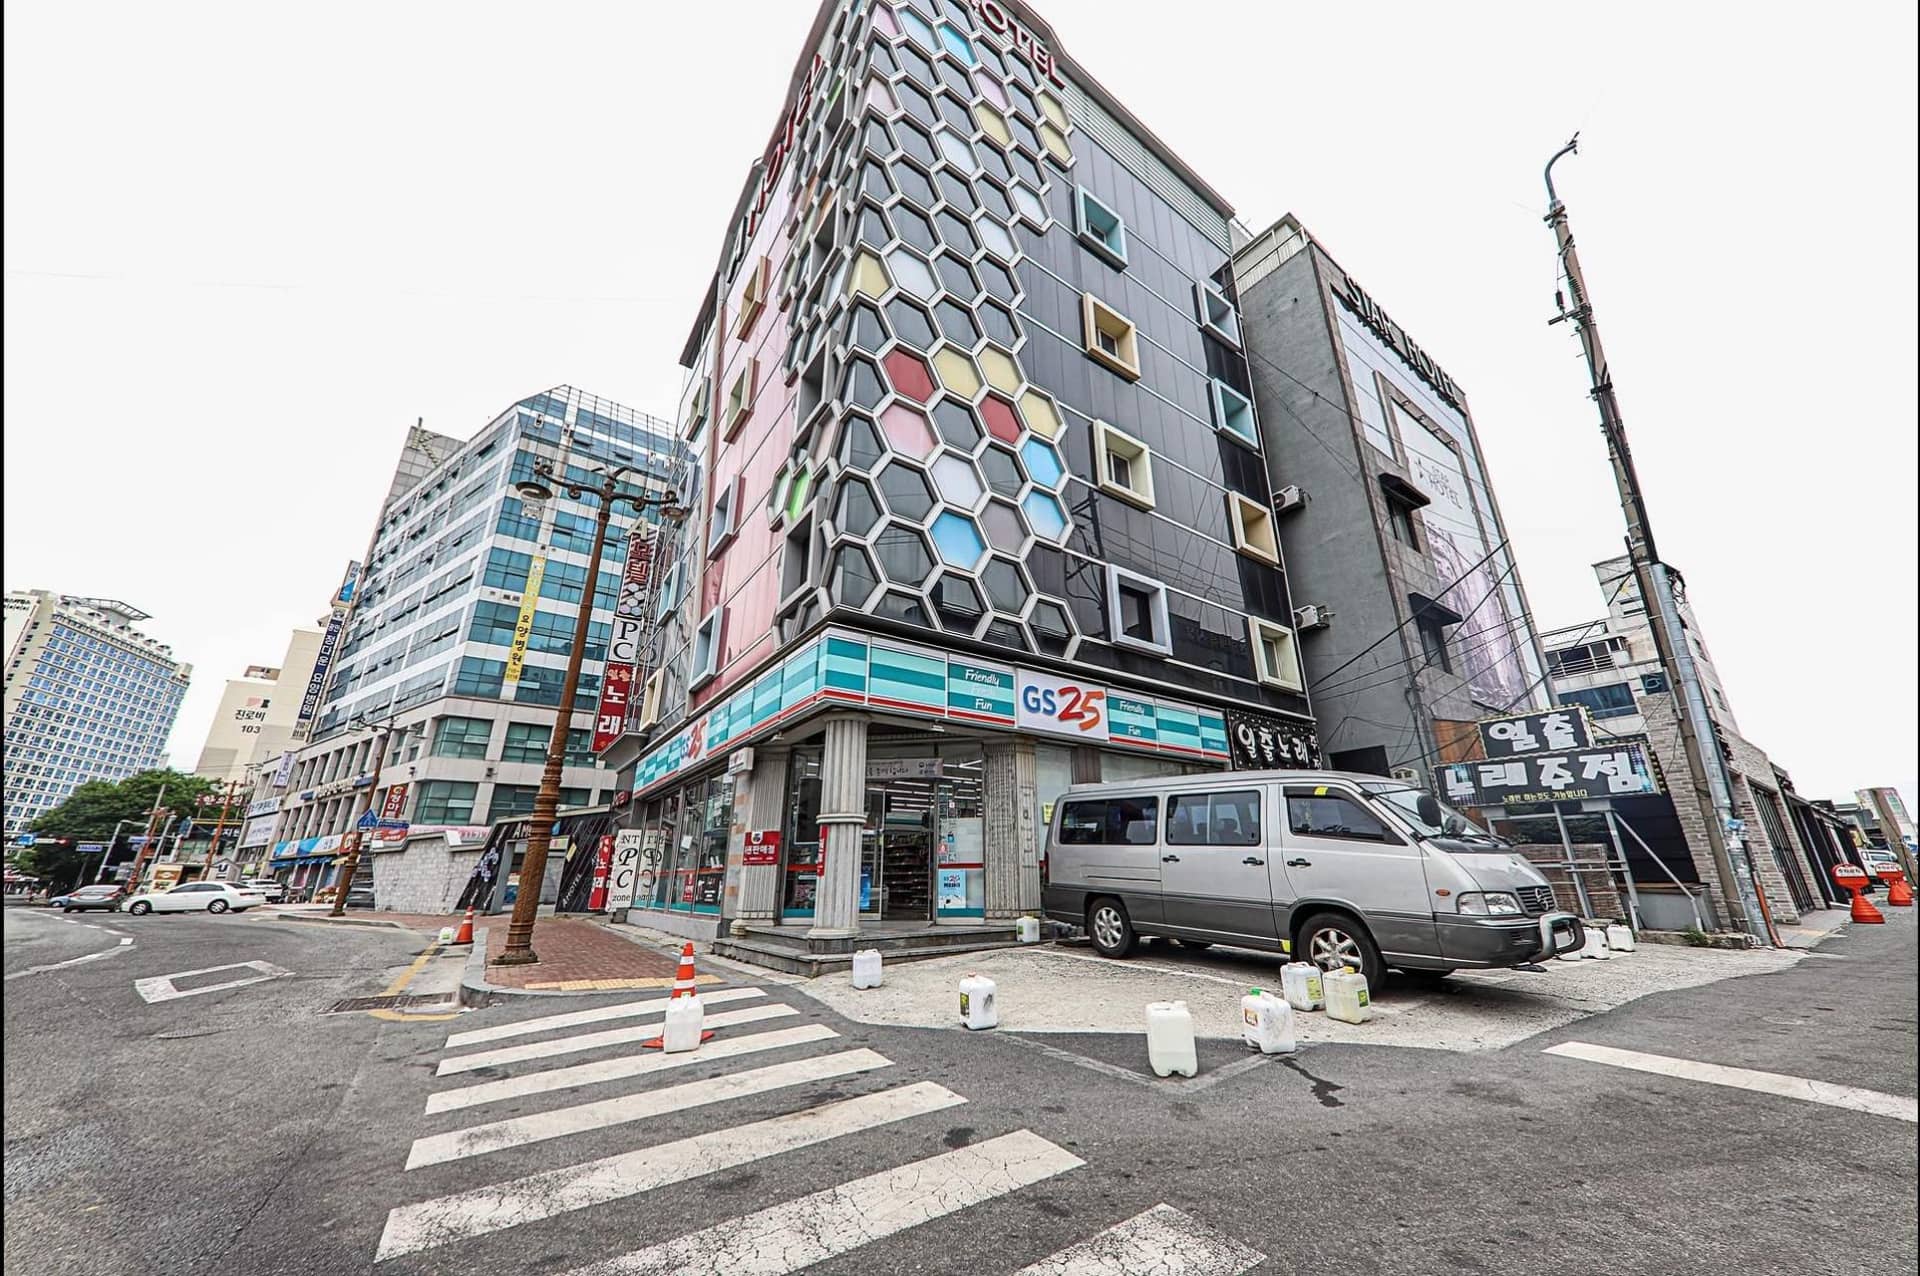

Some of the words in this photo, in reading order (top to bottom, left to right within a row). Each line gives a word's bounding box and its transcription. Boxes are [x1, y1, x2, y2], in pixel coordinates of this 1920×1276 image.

[969, 0, 1066, 90] OTEL
[1344, 274, 1396, 344] STAR
[1402, 330, 1461, 406] HOTEL
[625, 517, 649, 541] A
[629, 540, 651, 585] 모텔
[965, 669, 1000, 688] Friendly
[598, 685, 626, 735] 노래
[975, 698, 993, 711] Fun
[1022, 685, 1105, 732] GS25
[1119, 700, 1145, 715] Friendly
[241, 725, 262, 734] 103
[680, 719, 708, 760] GS25
[1127, 725, 1142, 736] Fun
[1488, 713, 1579, 752] 일출
[1444, 750, 1642, 797] 노래주점
[612, 893, 631, 902] zone
